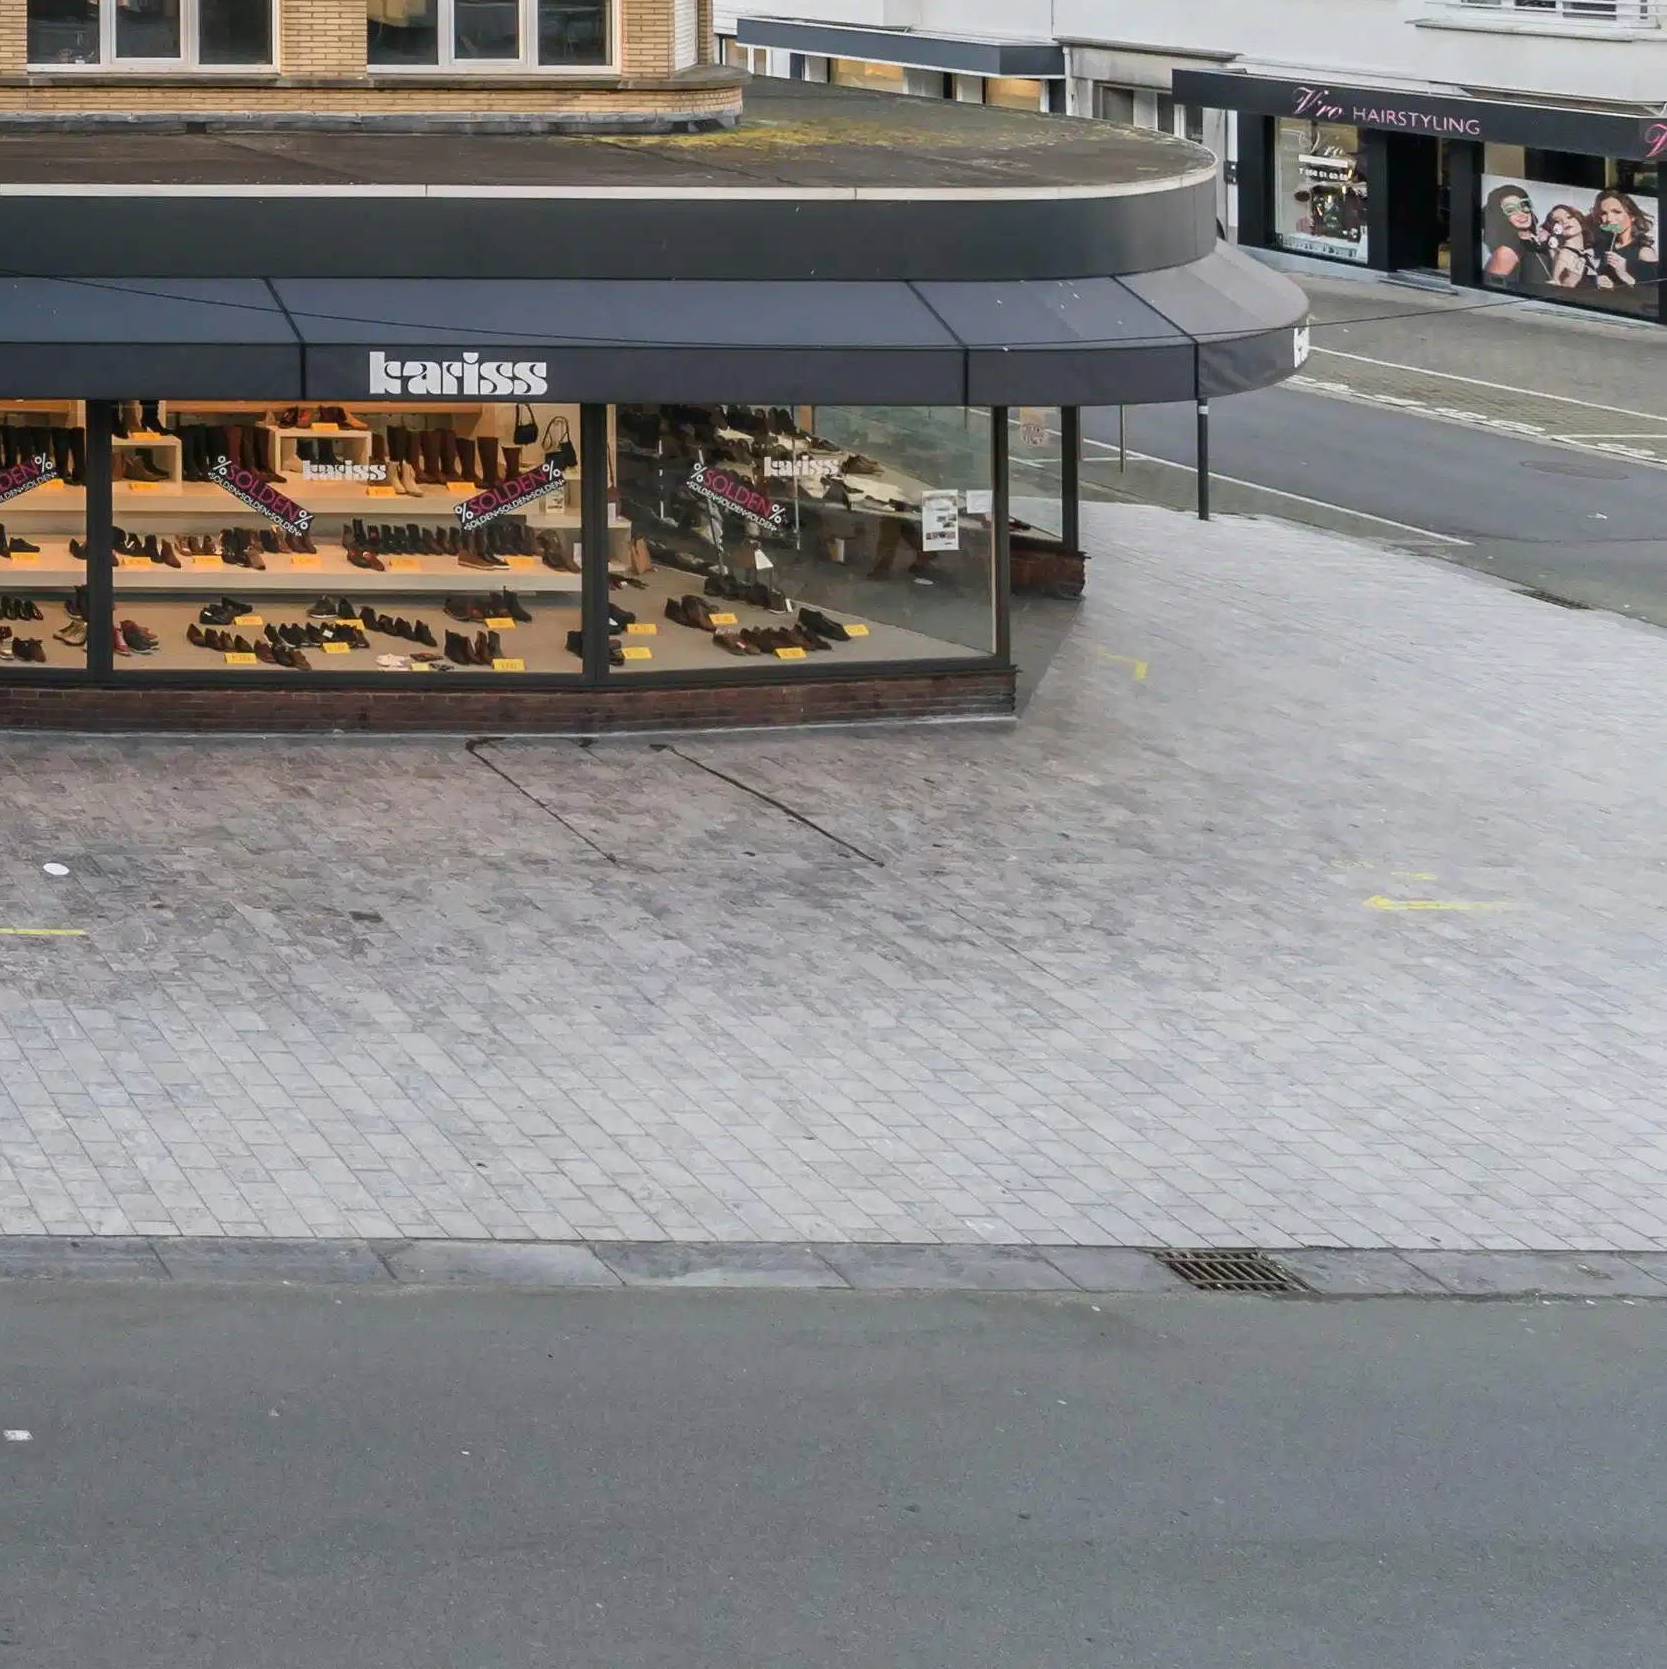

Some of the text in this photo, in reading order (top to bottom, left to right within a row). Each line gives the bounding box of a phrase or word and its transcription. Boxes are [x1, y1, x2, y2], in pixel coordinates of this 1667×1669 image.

[1352, 106, 1481, 135] HAIRSTYLING
[369, 351, 548, 395] kariss
[303, 460, 387, 481] kariss
[764, 455, 839, 477] kariss
